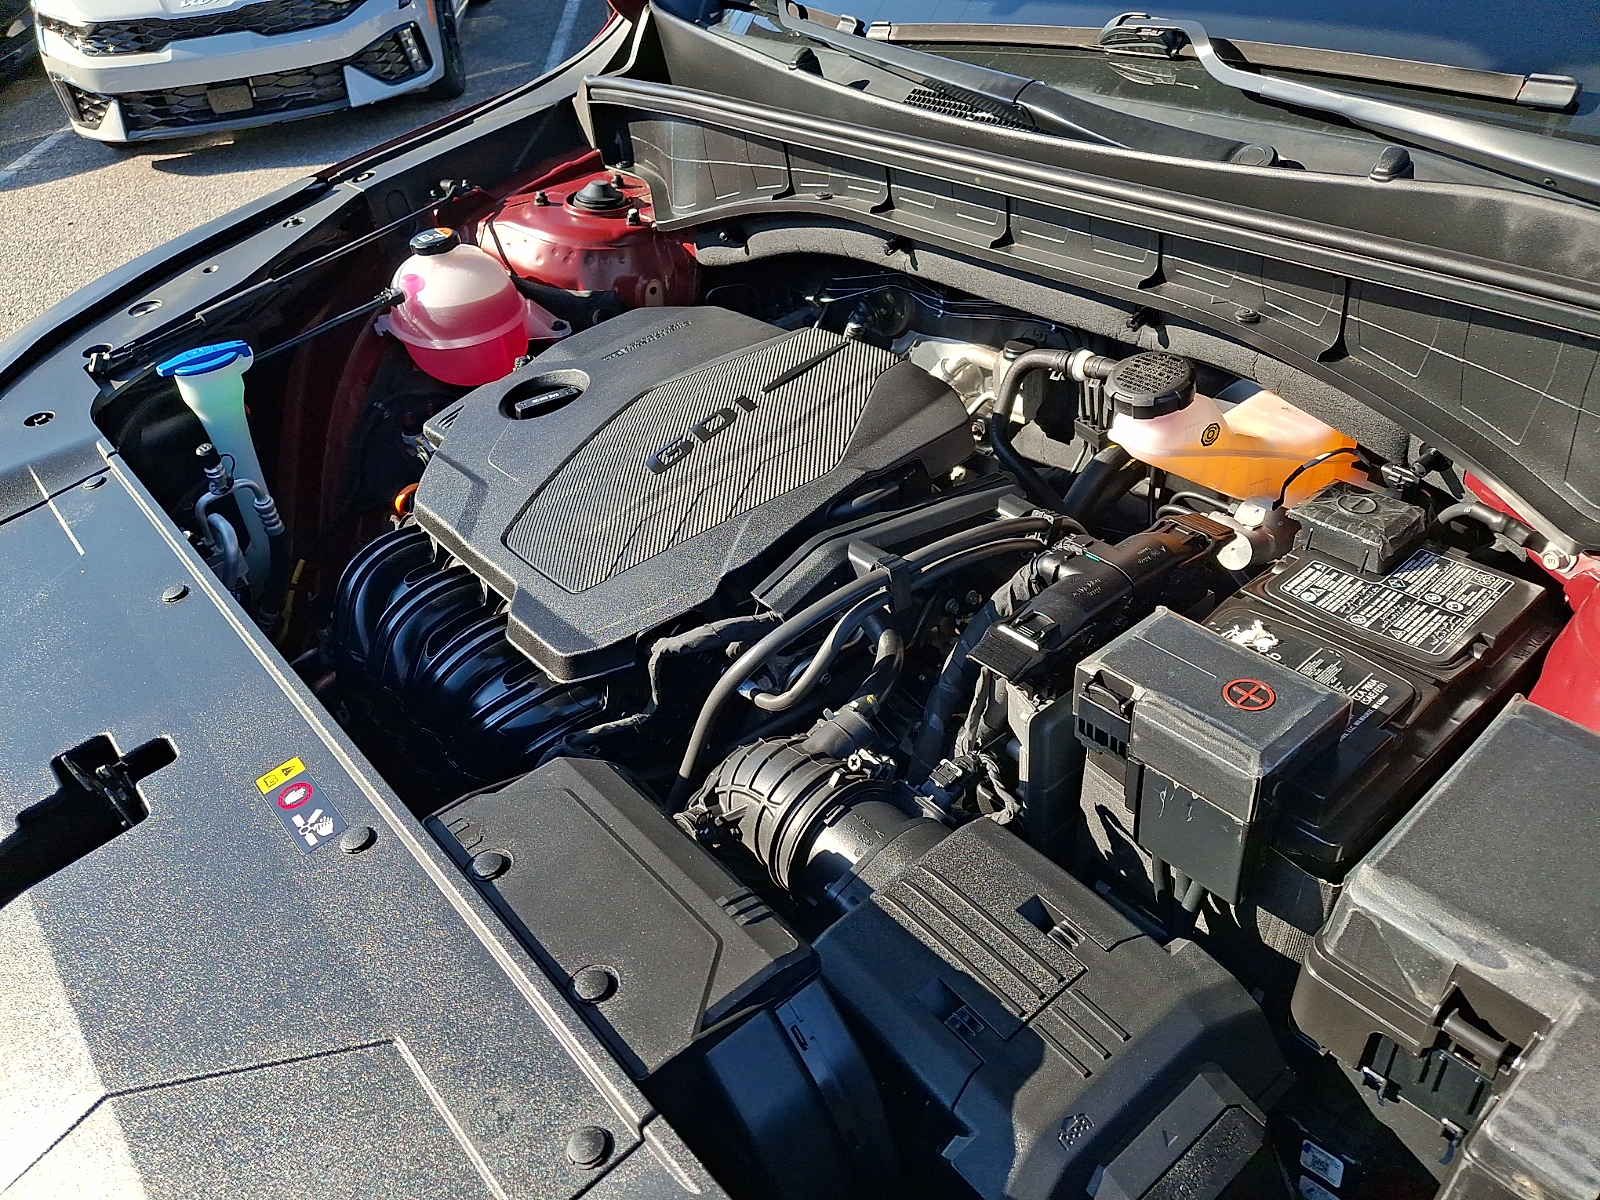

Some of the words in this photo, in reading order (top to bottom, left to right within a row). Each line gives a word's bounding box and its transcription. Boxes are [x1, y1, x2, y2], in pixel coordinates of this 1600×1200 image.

[645, 395, 759, 475] GDI
[1352, 690, 1367, 701] CCA
[1360, 682, 1388, 705] (SAE/EN)
